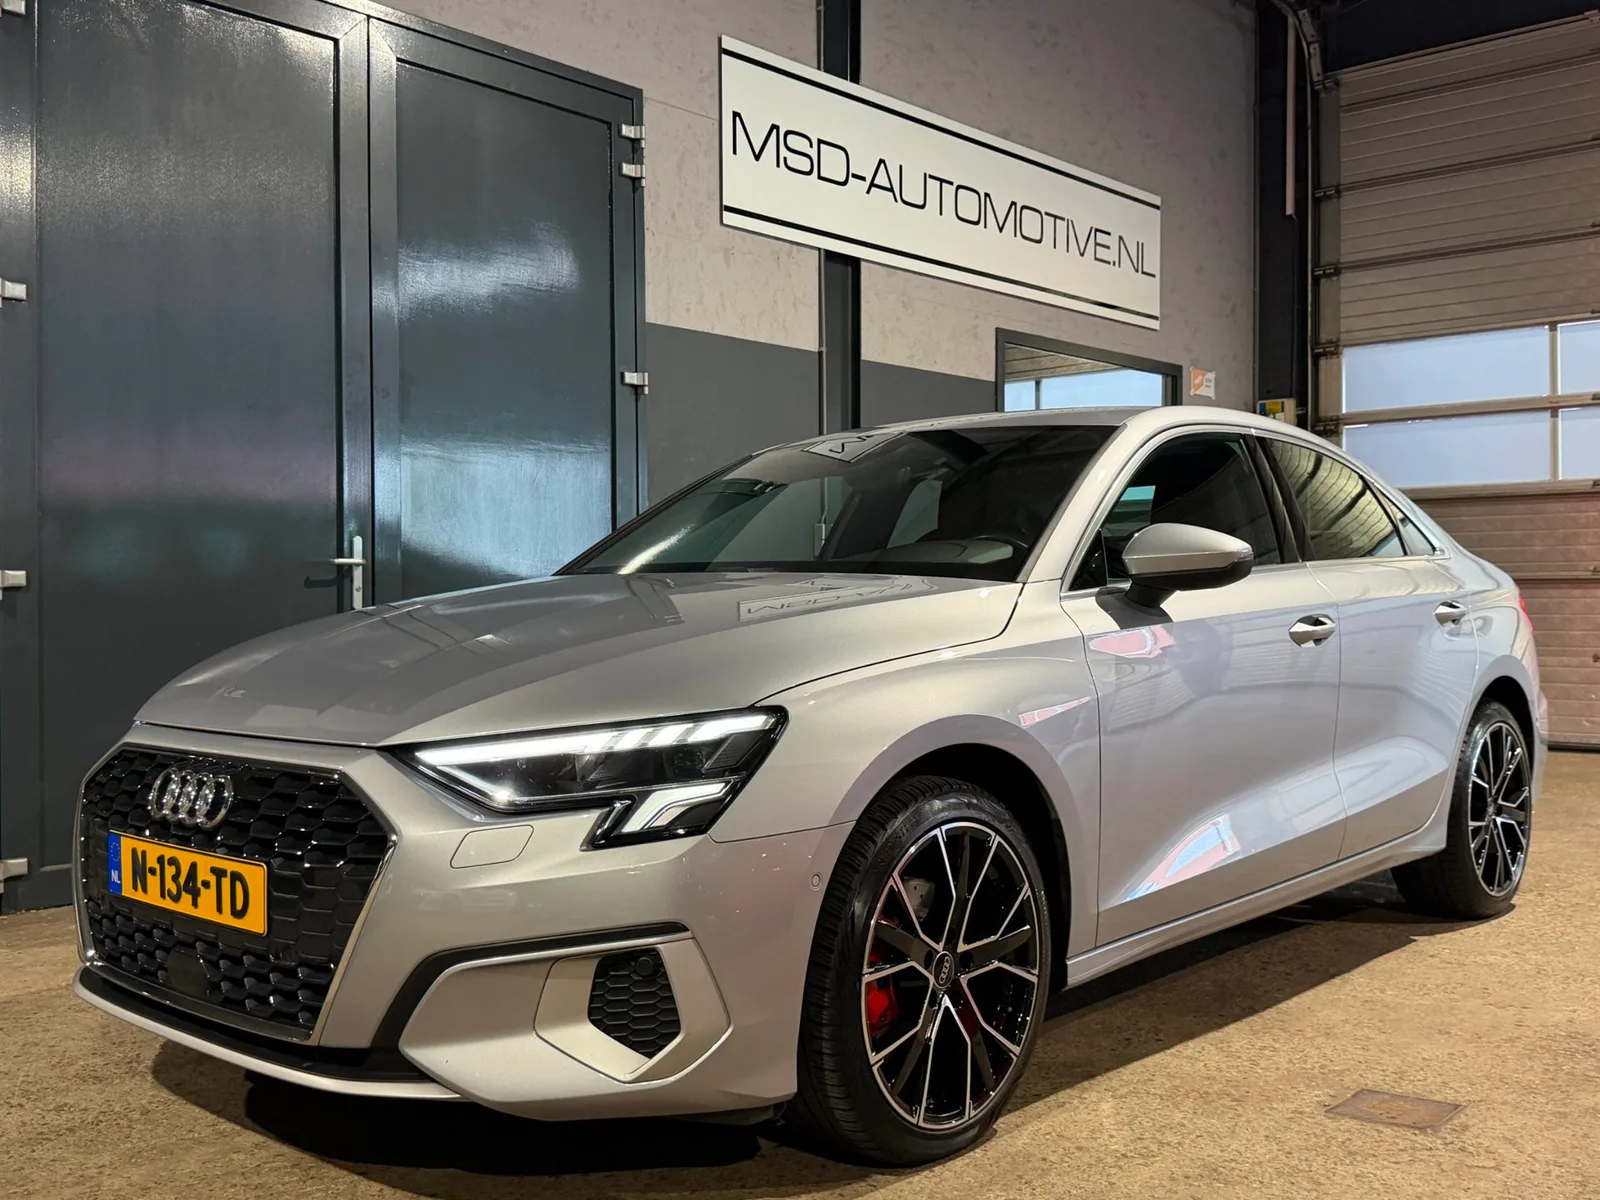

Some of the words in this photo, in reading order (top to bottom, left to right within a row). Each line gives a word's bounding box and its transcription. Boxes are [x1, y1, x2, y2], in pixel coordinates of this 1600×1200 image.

[732, 110, 1156, 278] MSD-AUTOMOTIVE.NL
[111, 869, 121, 884] NL
[131, 847, 250, 920] N-134-TD
